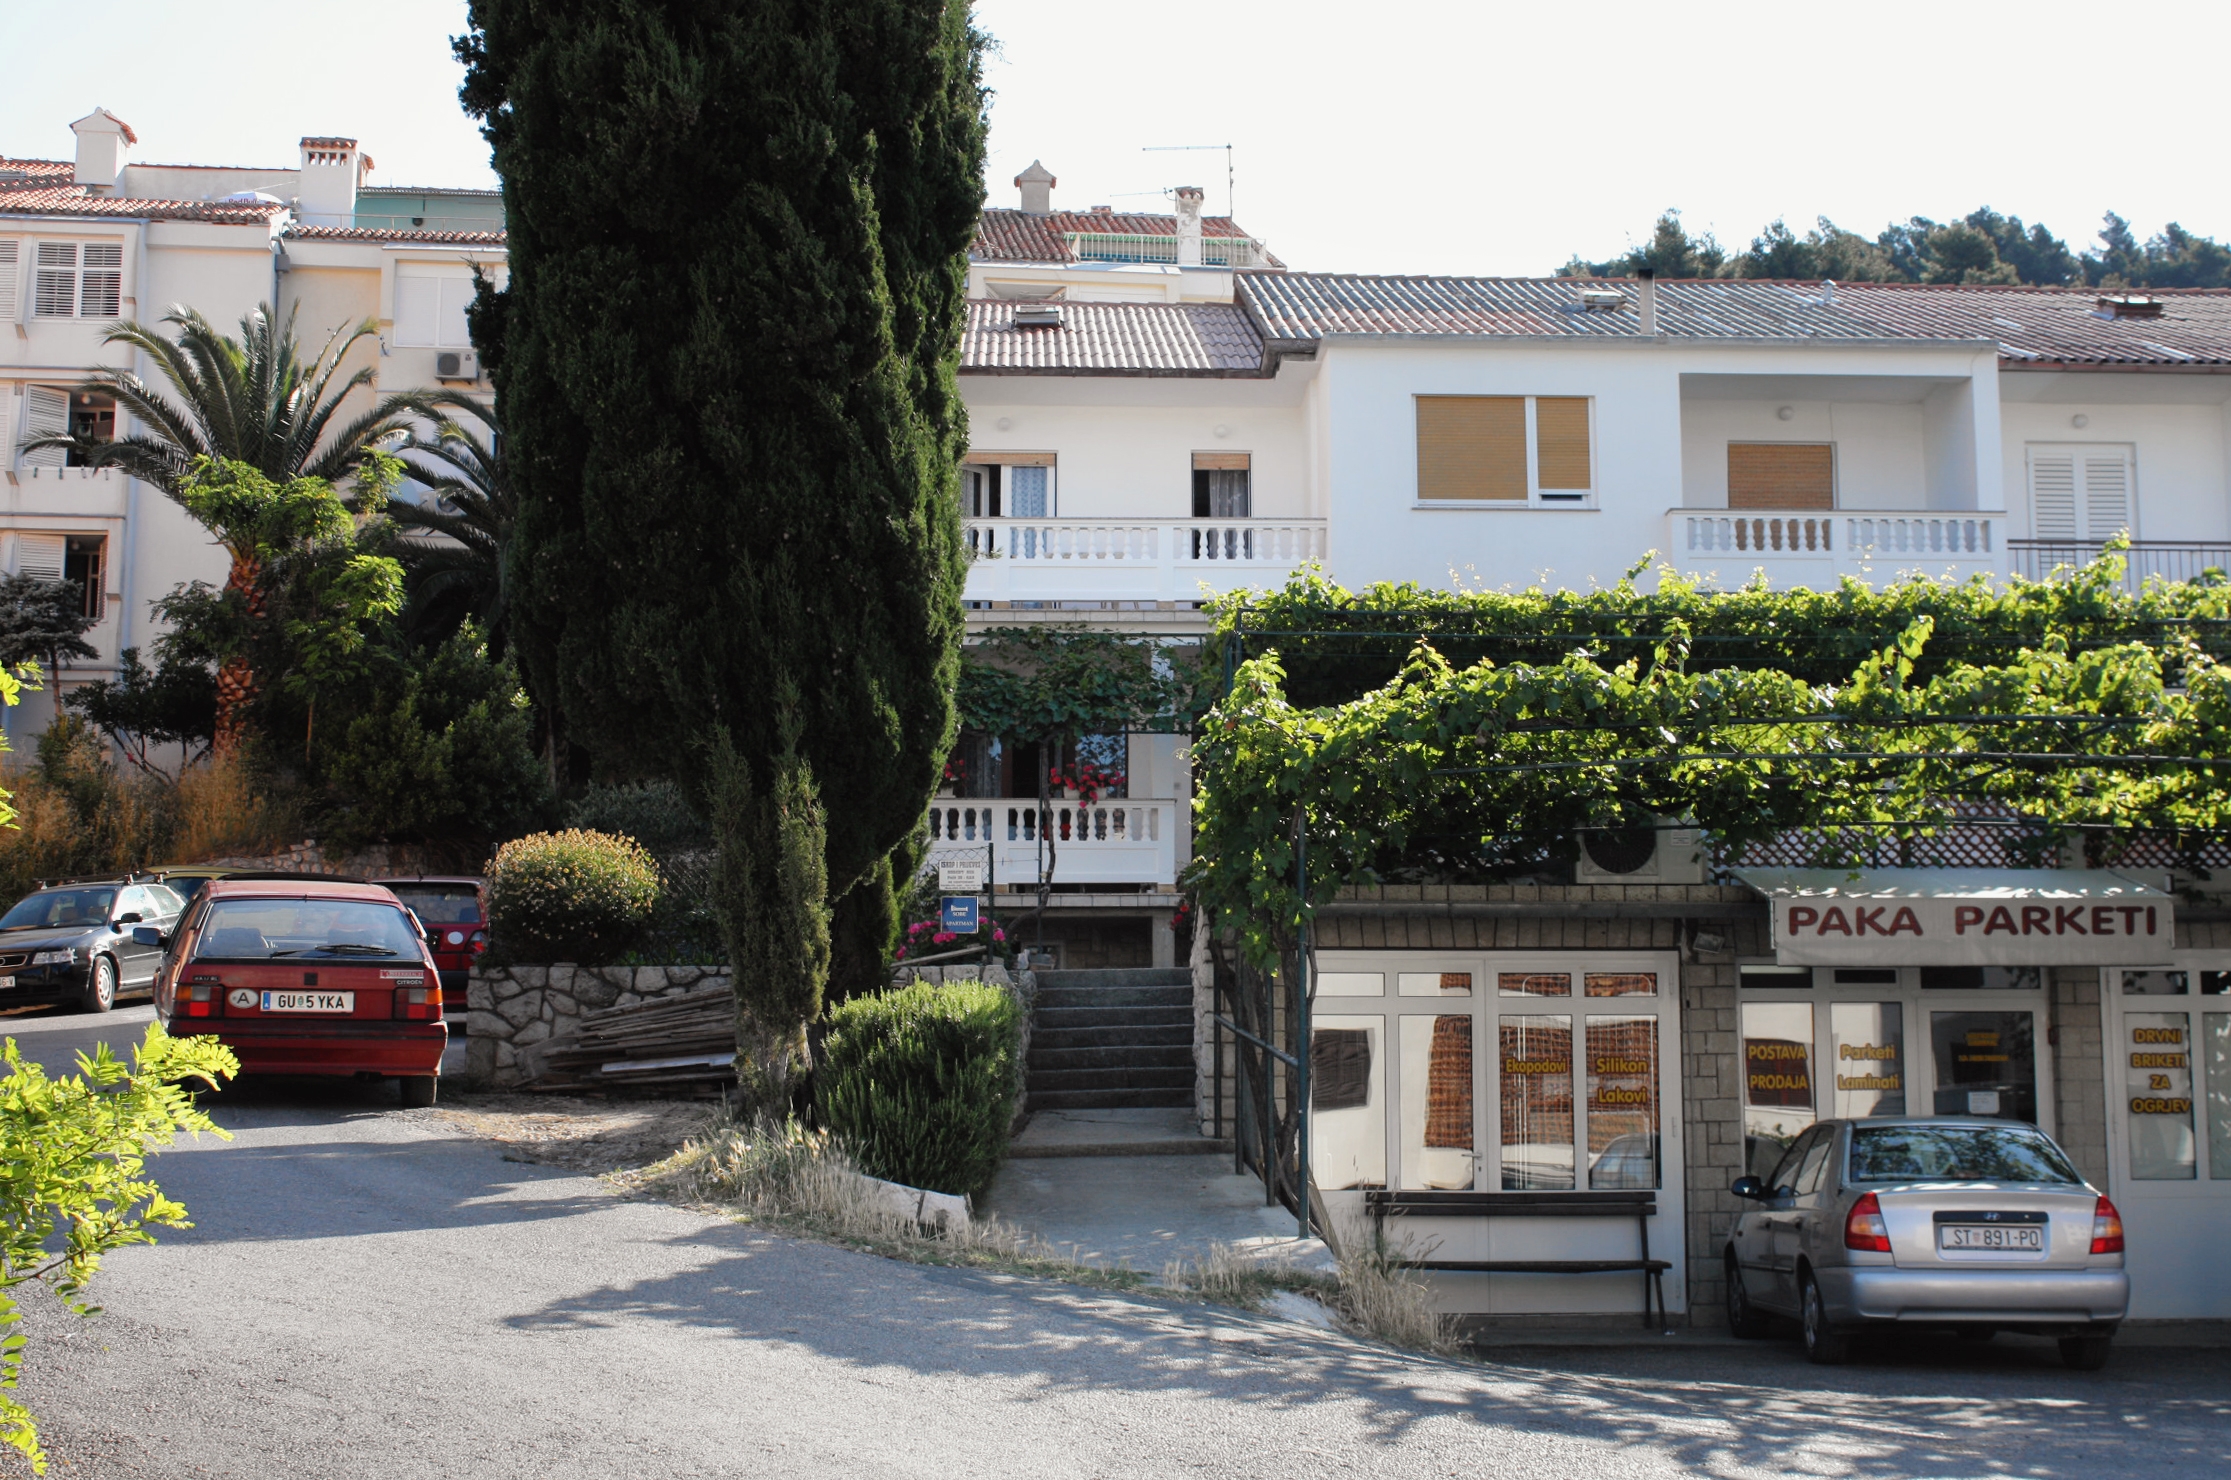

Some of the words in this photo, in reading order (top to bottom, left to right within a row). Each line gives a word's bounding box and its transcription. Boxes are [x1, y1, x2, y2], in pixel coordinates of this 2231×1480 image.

[1788, 905, 1924, 937] PAKA
[1954, 905, 2157, 936] PARKETI
[236, 991, 250, 1005] A
[278, 994, 296, 1009] GU
[2133, 1027, 2183, 1044] DRVNI
[1748, 1044, 1808, 1060] POSTAVA
[1840, 1042, 1897, 1061] Parketi
[2130, 1052, 2186, 1068] BRIKETI
[1505, 1057, 1567, 1076] Ekopodovi
[1596, 1057, 1649, 1073] Silikon
[1750, 1074, 1809, 1090] PRODAJA
[1837, 1072, 1900, 1091] Laminati
[2149, 1073, 2172, 1090] ZA
[1597, 1086, 1648, 1104] Lakovi
[2130, 1097, 2192, 1115] OGRJEV
[1953, 1228, 1971, 1246] ST
